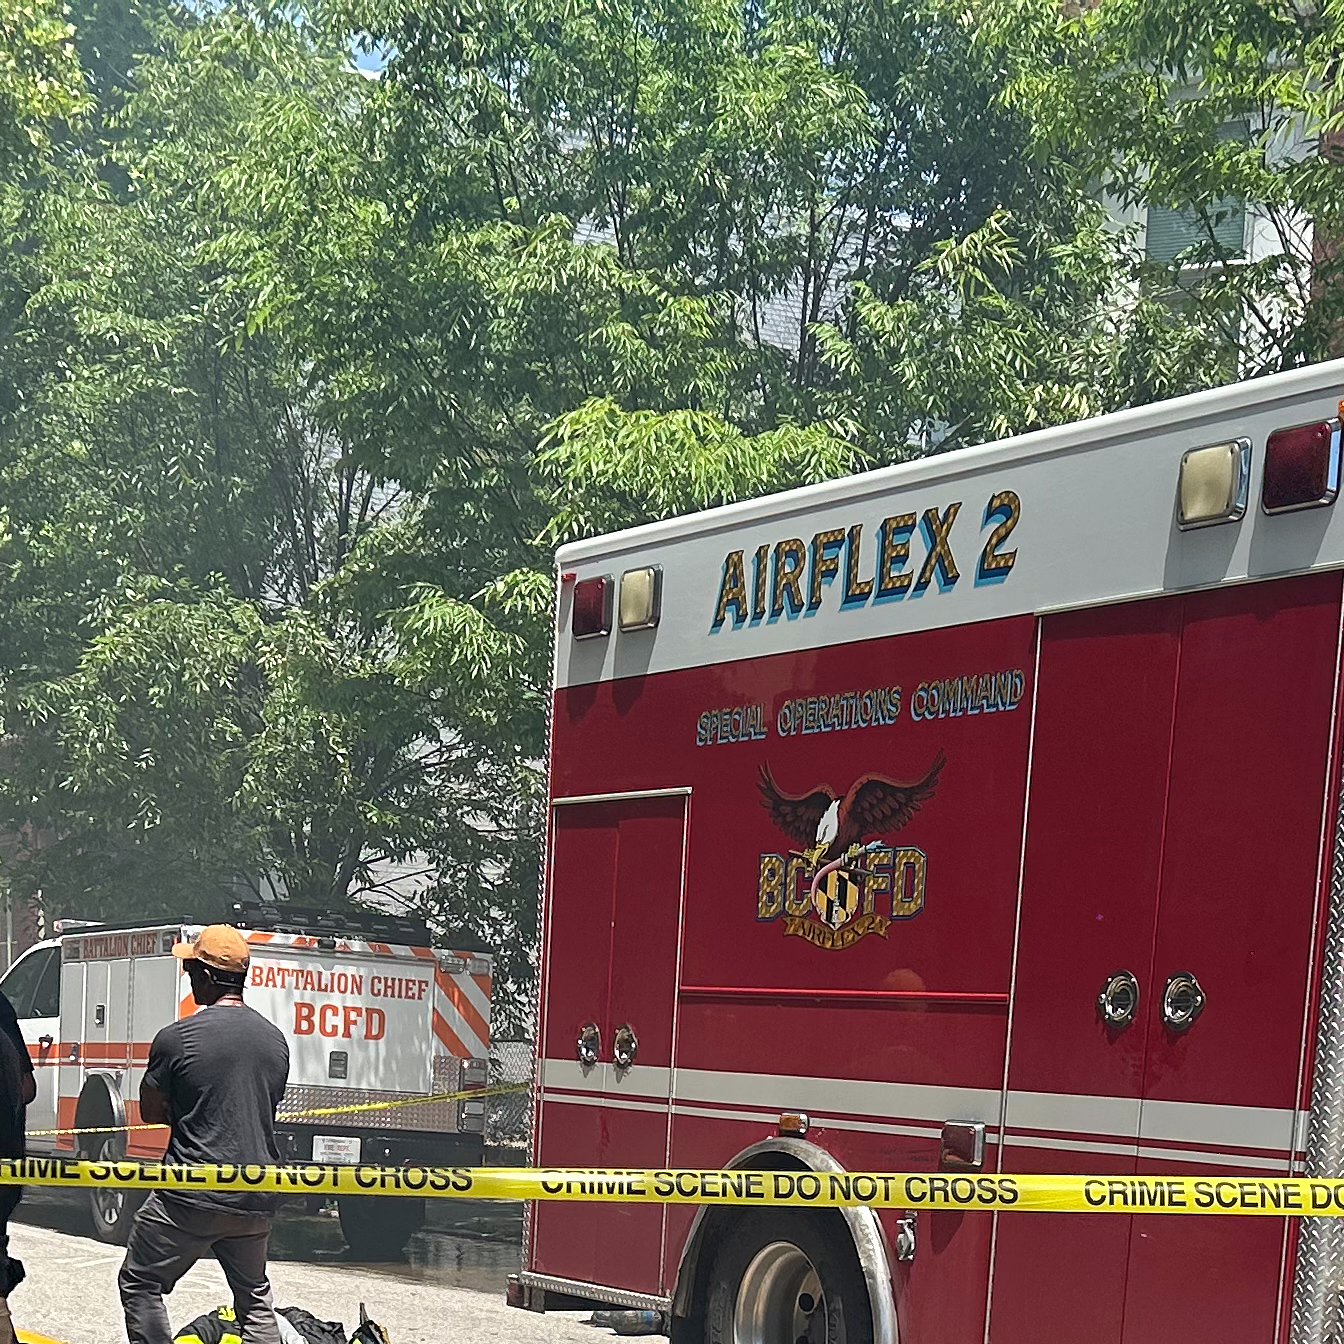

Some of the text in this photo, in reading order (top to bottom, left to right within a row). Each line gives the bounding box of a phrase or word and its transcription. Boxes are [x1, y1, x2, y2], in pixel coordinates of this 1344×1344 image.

[709, 490, 1021, 634] AIRFLEX 2
[696, 668, 1025, 746] SPECIAL OPERATIONS COMMAND
[83, 932, 158, 959] BATTALION CHIEF
[251, 965, 429, 1000] BATTALION CHIEF
[293, 1001, 386, 1041] BCFD
[89, 1159, 207, 1183] SCENE
[215, 1162, 266, 1185] DO
[275, 1164, 339, 1187] NOT
[354, 1166, 474, 1191] CROSS
[540, 1169, 1019, 1204] CRIME SCENE DO NOT CROSS
[1083, 1179, 1188, 1207] CRIME
[1194, 1181, 1303, 1210] SCENE
